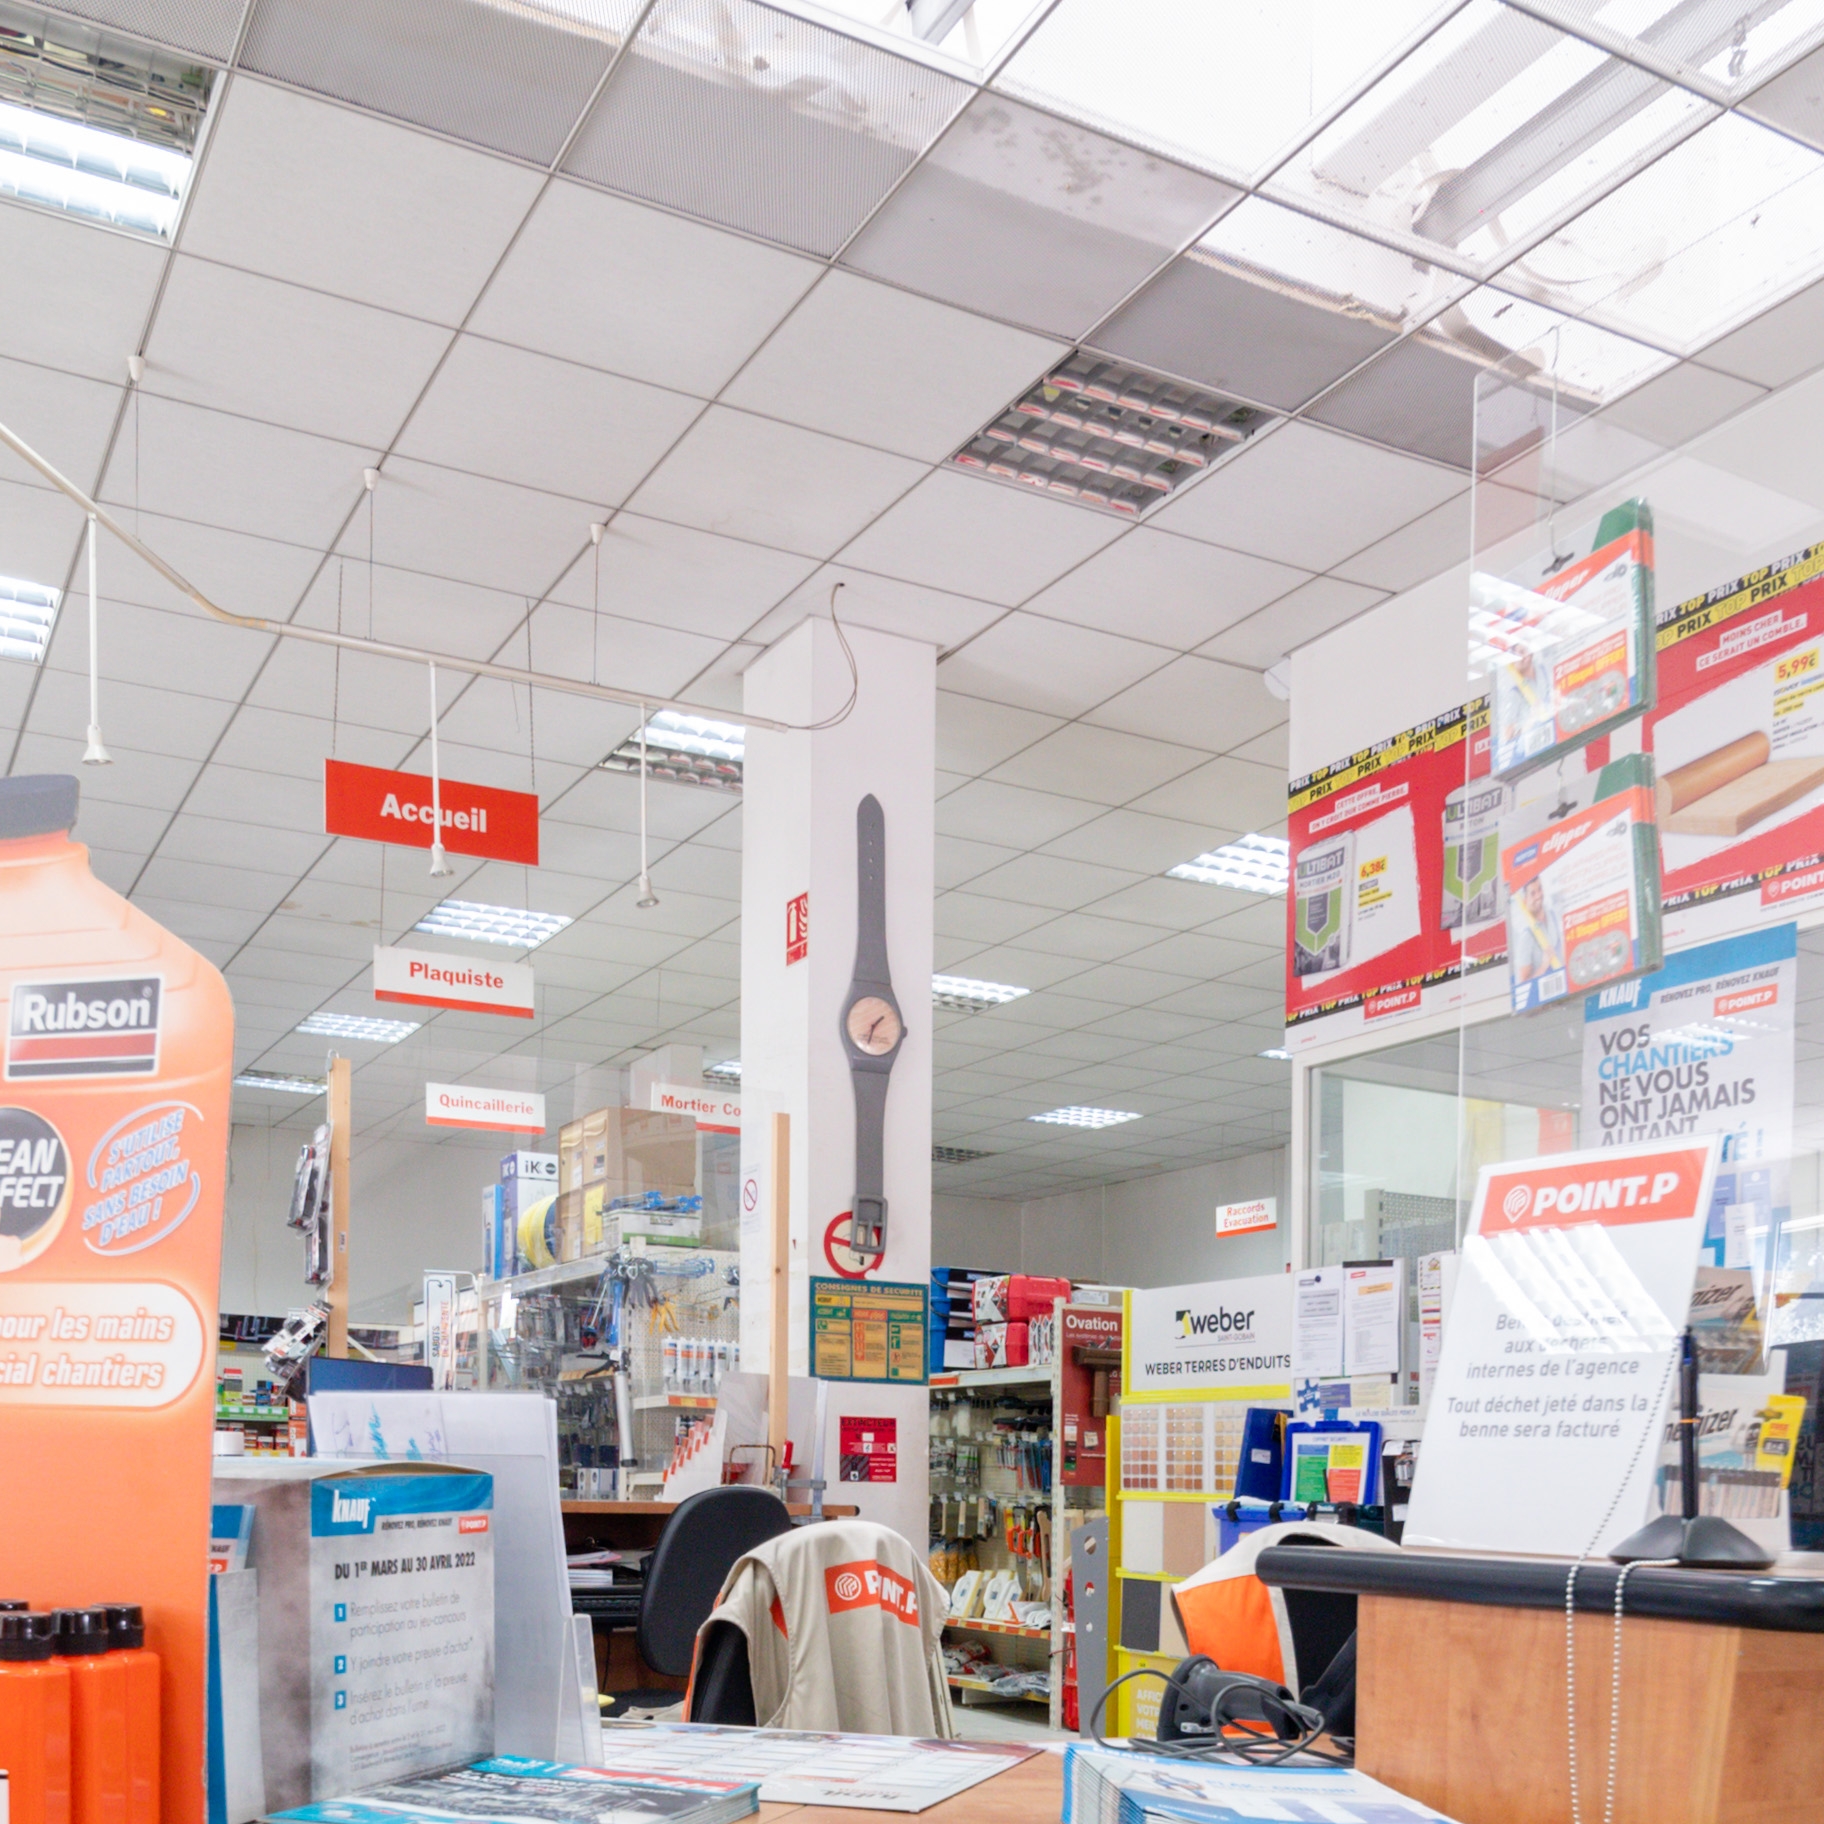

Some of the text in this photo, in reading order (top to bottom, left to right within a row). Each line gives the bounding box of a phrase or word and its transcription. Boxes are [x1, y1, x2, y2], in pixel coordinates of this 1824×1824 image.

[1679, 580, 1738, 615] TOP PRIX
[1722, 614, 1780, 646] MOINS CHER
[1712, 640, 1745, 662] SERAIT
[380, 794, 487, 833] Accueil
[1298, 848, 1344, 878] ULTIBAT
[409, 961, 504, 989] Plaquiste
[22, 991, 150, 1031] Rubson
[1377, 992, 1416, 1010] POINT.P
[1727, 989, 1773, 1011] POINT.P
[1600, 1023, 1650, 1056] VOS
[1598, 1030, 1734, 1081] CHANTIERS
[1599, 1061, 1709, 1106] NE VOUS
[439, 1094, 534, 1116] Quincaillerie
[661, 1095, 717, 1114] Mortier
[1599, 1078, 1756, 1130] ONT JAMAIS
[109, 1108, 185, 1164] S'UTILISE
[83, 1160, 189, 1229] SANS BESOIN
[1532, 1171, 1680, 1217] POINT.P
[1227, 1202, 1265, 1216] Raccords
[100, 1203, 150, 1246] D'EAU
[816, 1282, 867, 1293] CONSIGNES
[870, 1285, 881, 1293] DE
[51, 1307, 88, 1339] les
[96, 1308, 172, 1341] mains
[1065, 1315, 1118, 1332] Ovation
[1189, 1307, 1255, 1334] weber
[1504, 1339, 1535, 1354] aux
[42, 1354, 163, 1388] chantiers
[1145, 1355, 1290, 1376] WEBER TERRES D'ENDUITS
[1466, 1357, 1640, 1380] internes de l'agence
[1447, 1394, 1648, 1417] Tout déchet jeté dans la
[1459, 1418, 1620, 1439] benne sera facturé
[335, 1563, 350, 1580] DU
[371, 1559, 398, 1576] MARS
[401, 1557, 414, 1573] AU
[416, 1556, 427, 1571] 30
[429, 1554, 452, 1570] AVRIL
[455, 1552, 476, 1567] 2022
